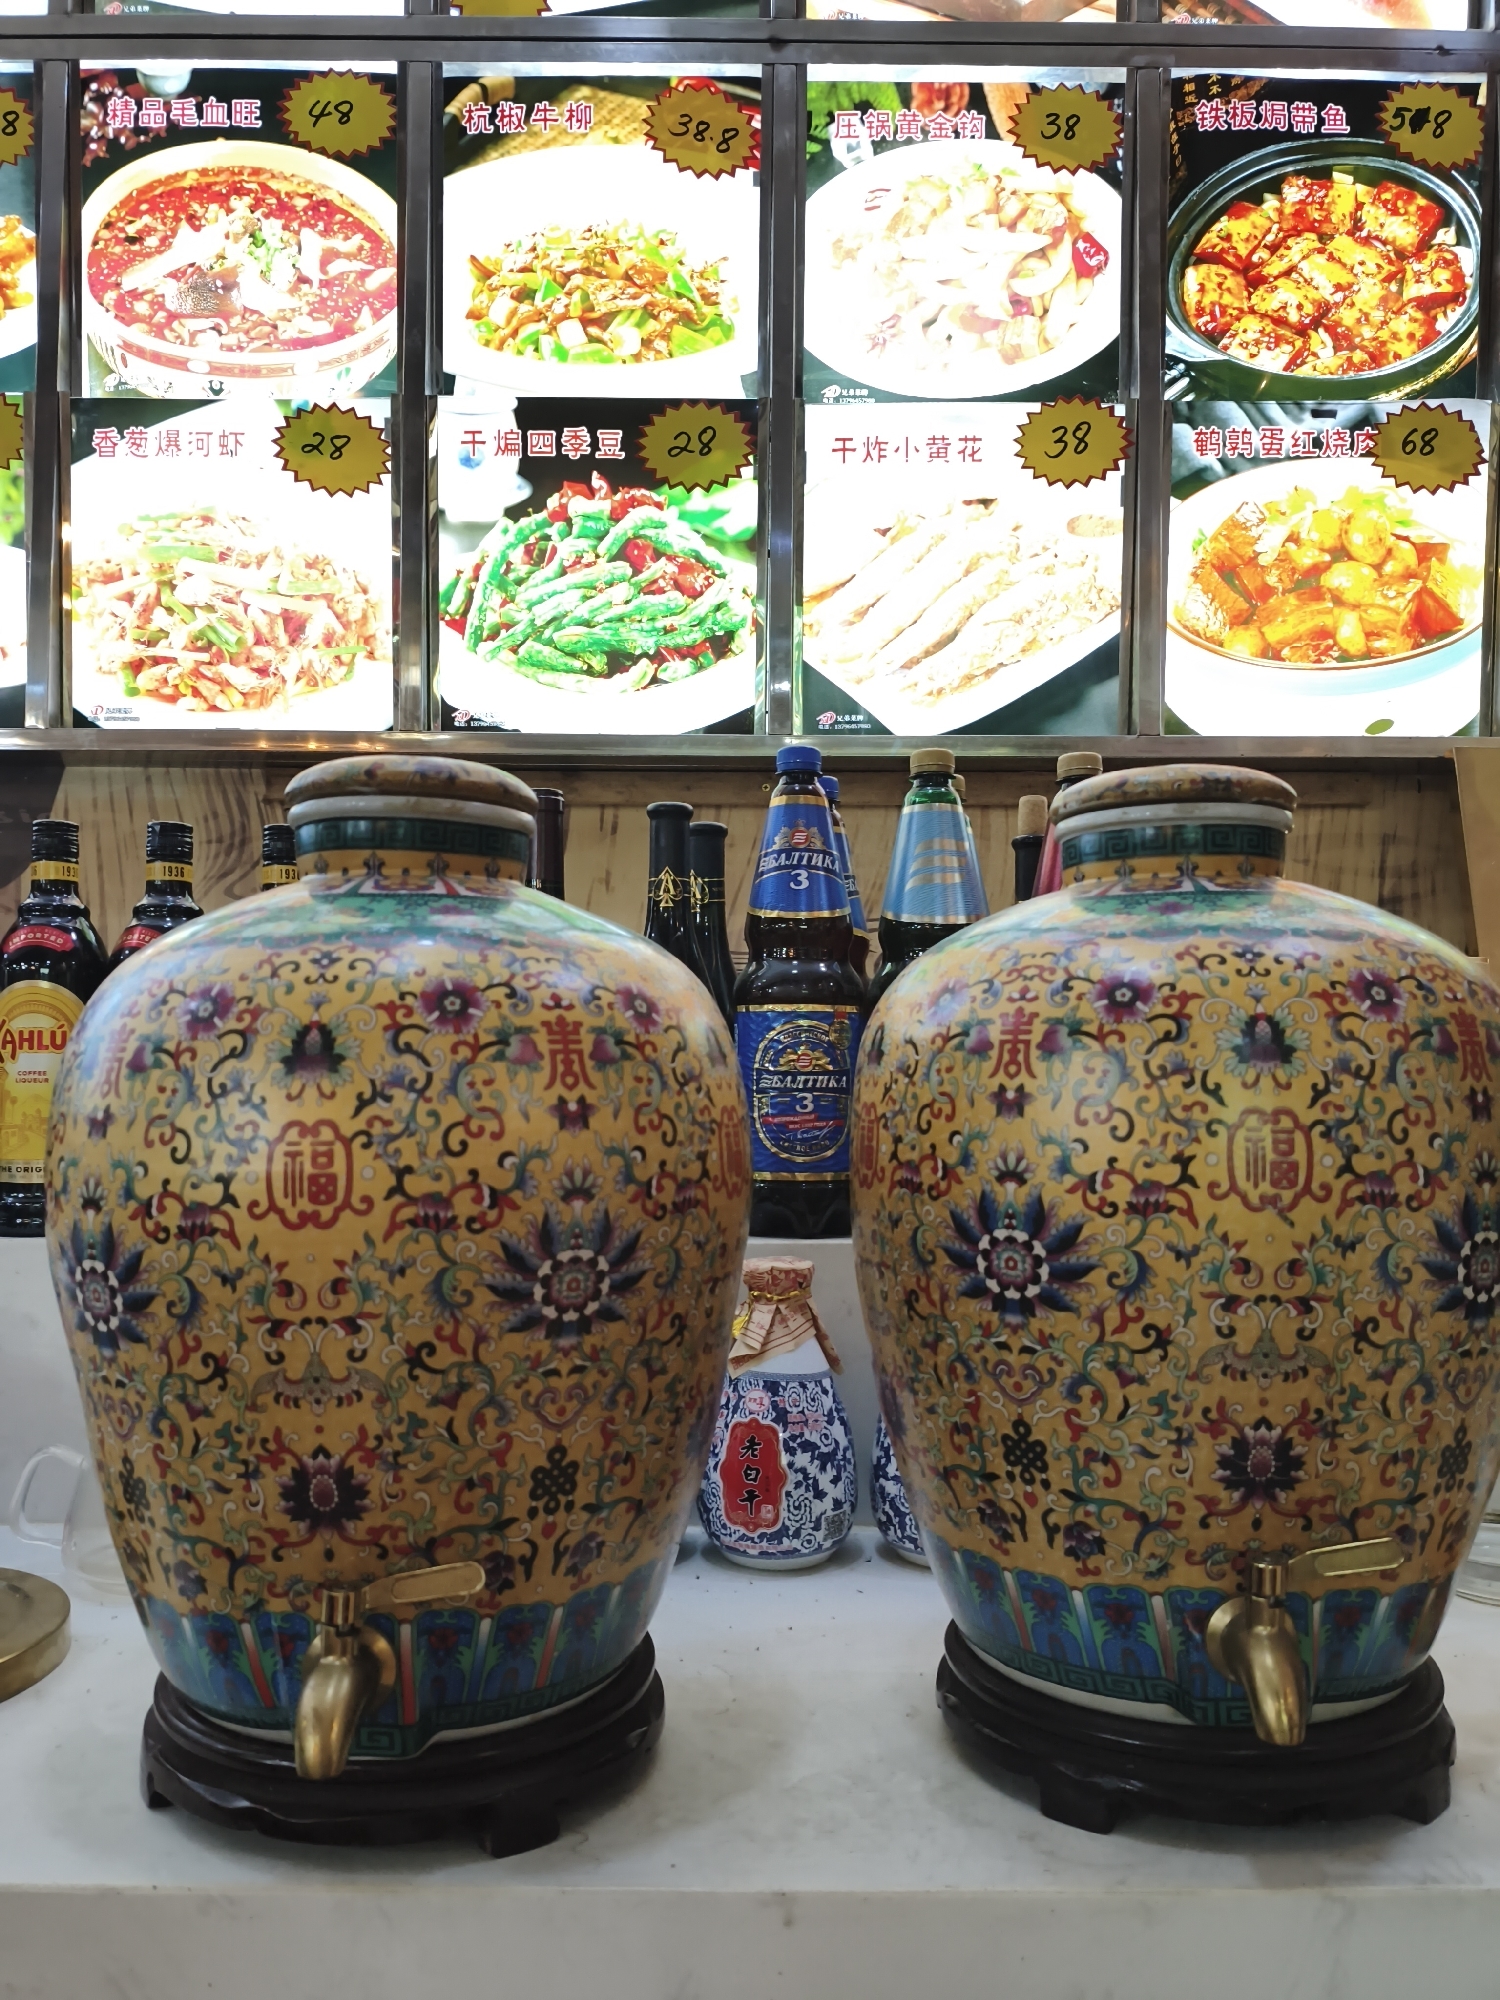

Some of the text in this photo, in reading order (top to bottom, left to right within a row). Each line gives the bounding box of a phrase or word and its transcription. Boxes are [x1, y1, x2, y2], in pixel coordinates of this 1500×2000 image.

[106, 96, 263, 128] 精品毛血旺
[308, 99, 354, 128] 48
[462, 101, 593, 134] 杭椒牛柳
[833, 109, 987, 142] 压锅黄金钩
[1040, 112, 1081, 141] 38
[1195, 98, 1351, 134] 铁板焗带鱼
[668, 113, 740, 153] 38.8
[92, 427, 246, 459] 香葱爆河虾
[301, 431, 352, 461] 28
[460, 426, 626, 460] 干煸四季豆
[667, 425, 718, 458] 28
[831, 434, 983, 464] 干炸小黄花
[1044, 421, 1092, 458] 38
[1401, 427, 1440, 457] 68
[163, 865, 185, 878] 1936
[766, 851, 841, 874] БАЛТИКА
[789, 869, 810, 890] 3
[9, 931, 64, 947] IMPORTED
[770, 1074, 847, 1089] БАЛТИКА
[795, 1092, 815, 1113] 3
[282, 1140, 339, 1208] 福
[1243, 1126, 1300, 1191] 福
[736, 1433, 764, 1518] 老白干
